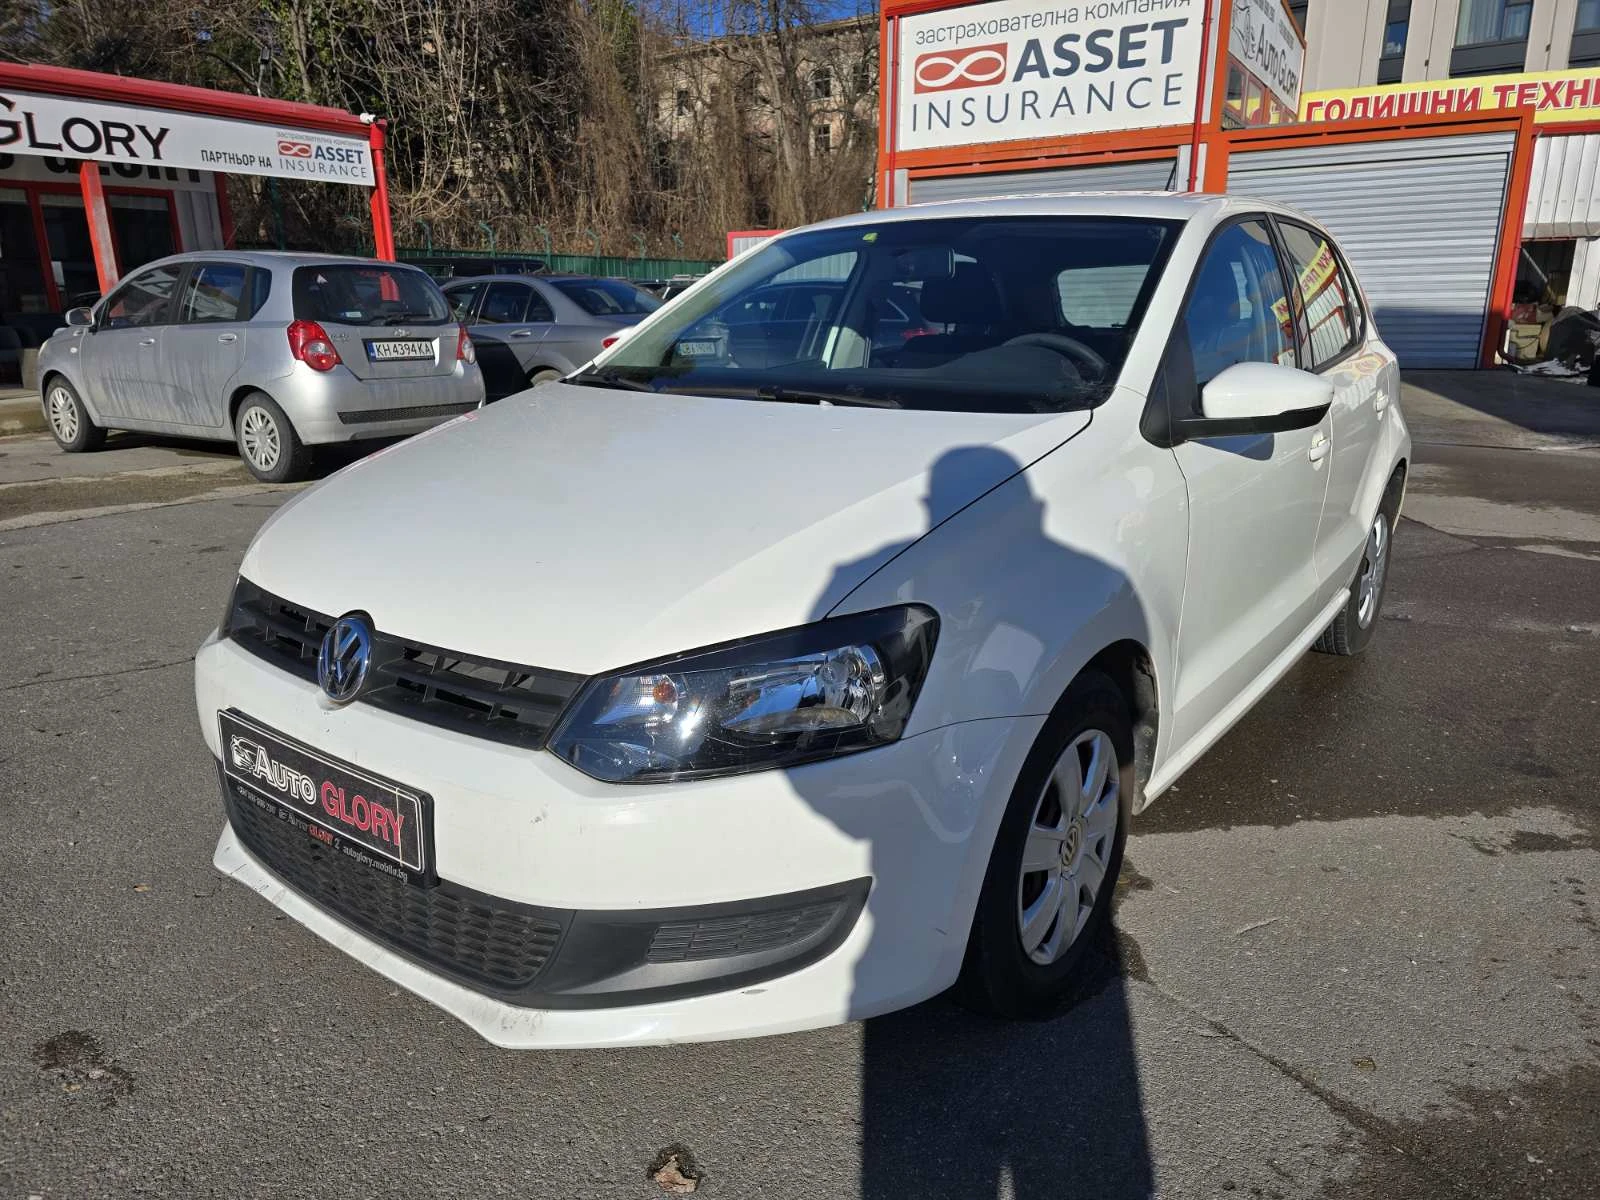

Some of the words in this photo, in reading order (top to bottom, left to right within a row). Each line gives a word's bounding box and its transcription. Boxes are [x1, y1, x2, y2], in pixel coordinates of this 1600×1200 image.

[915, 8, 1078, 46] застрахователна
[1013, 18, 1189, 82] ASSET
[911, 73, 1184, 132] INSURANCE
[201, 149, 256, 167] ПАРТНЬОР
[260, 156, 272, 168] НА
[280, 158, 367, 178] INSURANCE
[314, 145, 364, 165] ASSET
[320, 780, 405, 847] GLORY
